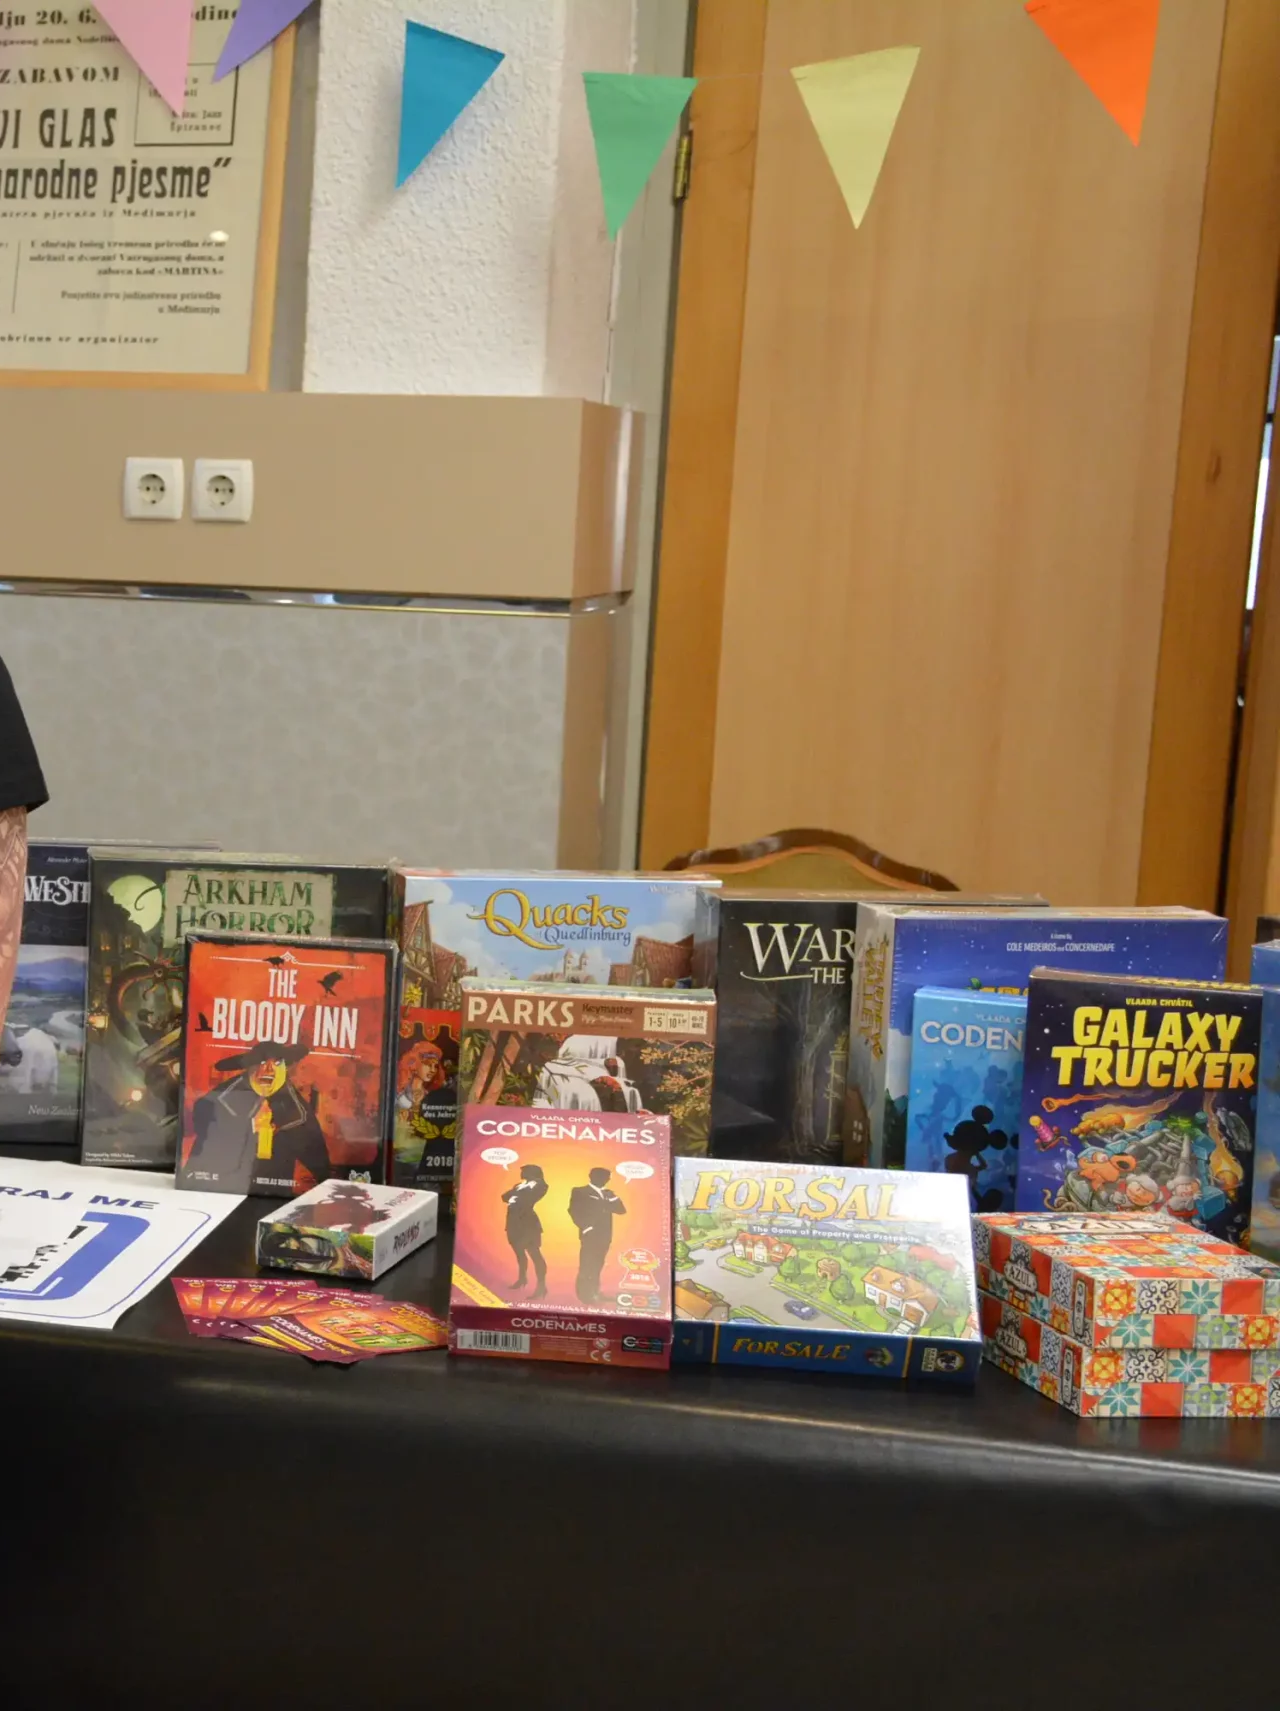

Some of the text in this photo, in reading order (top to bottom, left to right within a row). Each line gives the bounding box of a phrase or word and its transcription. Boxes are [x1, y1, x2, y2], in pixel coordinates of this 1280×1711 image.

[36, 10, 68, 26] 20.
[78, 9, 97, 25] 6.
[39, 107, 117, 149] GLAS
[183, 874, 313, 910] ARKHAM
[175, 906, 315, 939] HORROR
[466, 888, 630, 951] Quacks
[544, 924, 631, 947] Quedlinburg
[1006, 942, 1022, 952] COLE
[1024, 942, 1056, 952] MEDEIROS
[1065, 942, 1115, 953] CONCERNEDAPE
[742, 922, 856, 975] WAR
[268, 968, 298, 999] THE
[810, 967, 846, 984] THE
[467, 995, 573, 1028] PARKS
[582, 1003, 635, 1015] Keymaster
[212, 998, 358, 1049] BLOODY INN
[1073, 1006, 1242, 1053] GALAXY
[1051, 1046, 1257, 1089] TRUCKER
[476, 1119, 656, 1145] CODENAMES
[426, 1156, 454, 1168] 2018
[89, 1195, 160, 1210] ME
[687, 1170, 796, 1214] FOR
[752, 1225, 770, 1233] The
[771, 1226, 799, 1235] Game
[812, 1229, 851, 1241] Property
[852, 1231, 871, 1239] and
[1007, 1264, 1033, 1289] AZUL
[511, 1317, 607, 1333] CODENAMES
[732, 1338, 852, 1360] FOR SALE
[1000, 1334, 1024, 1354] AZUL
